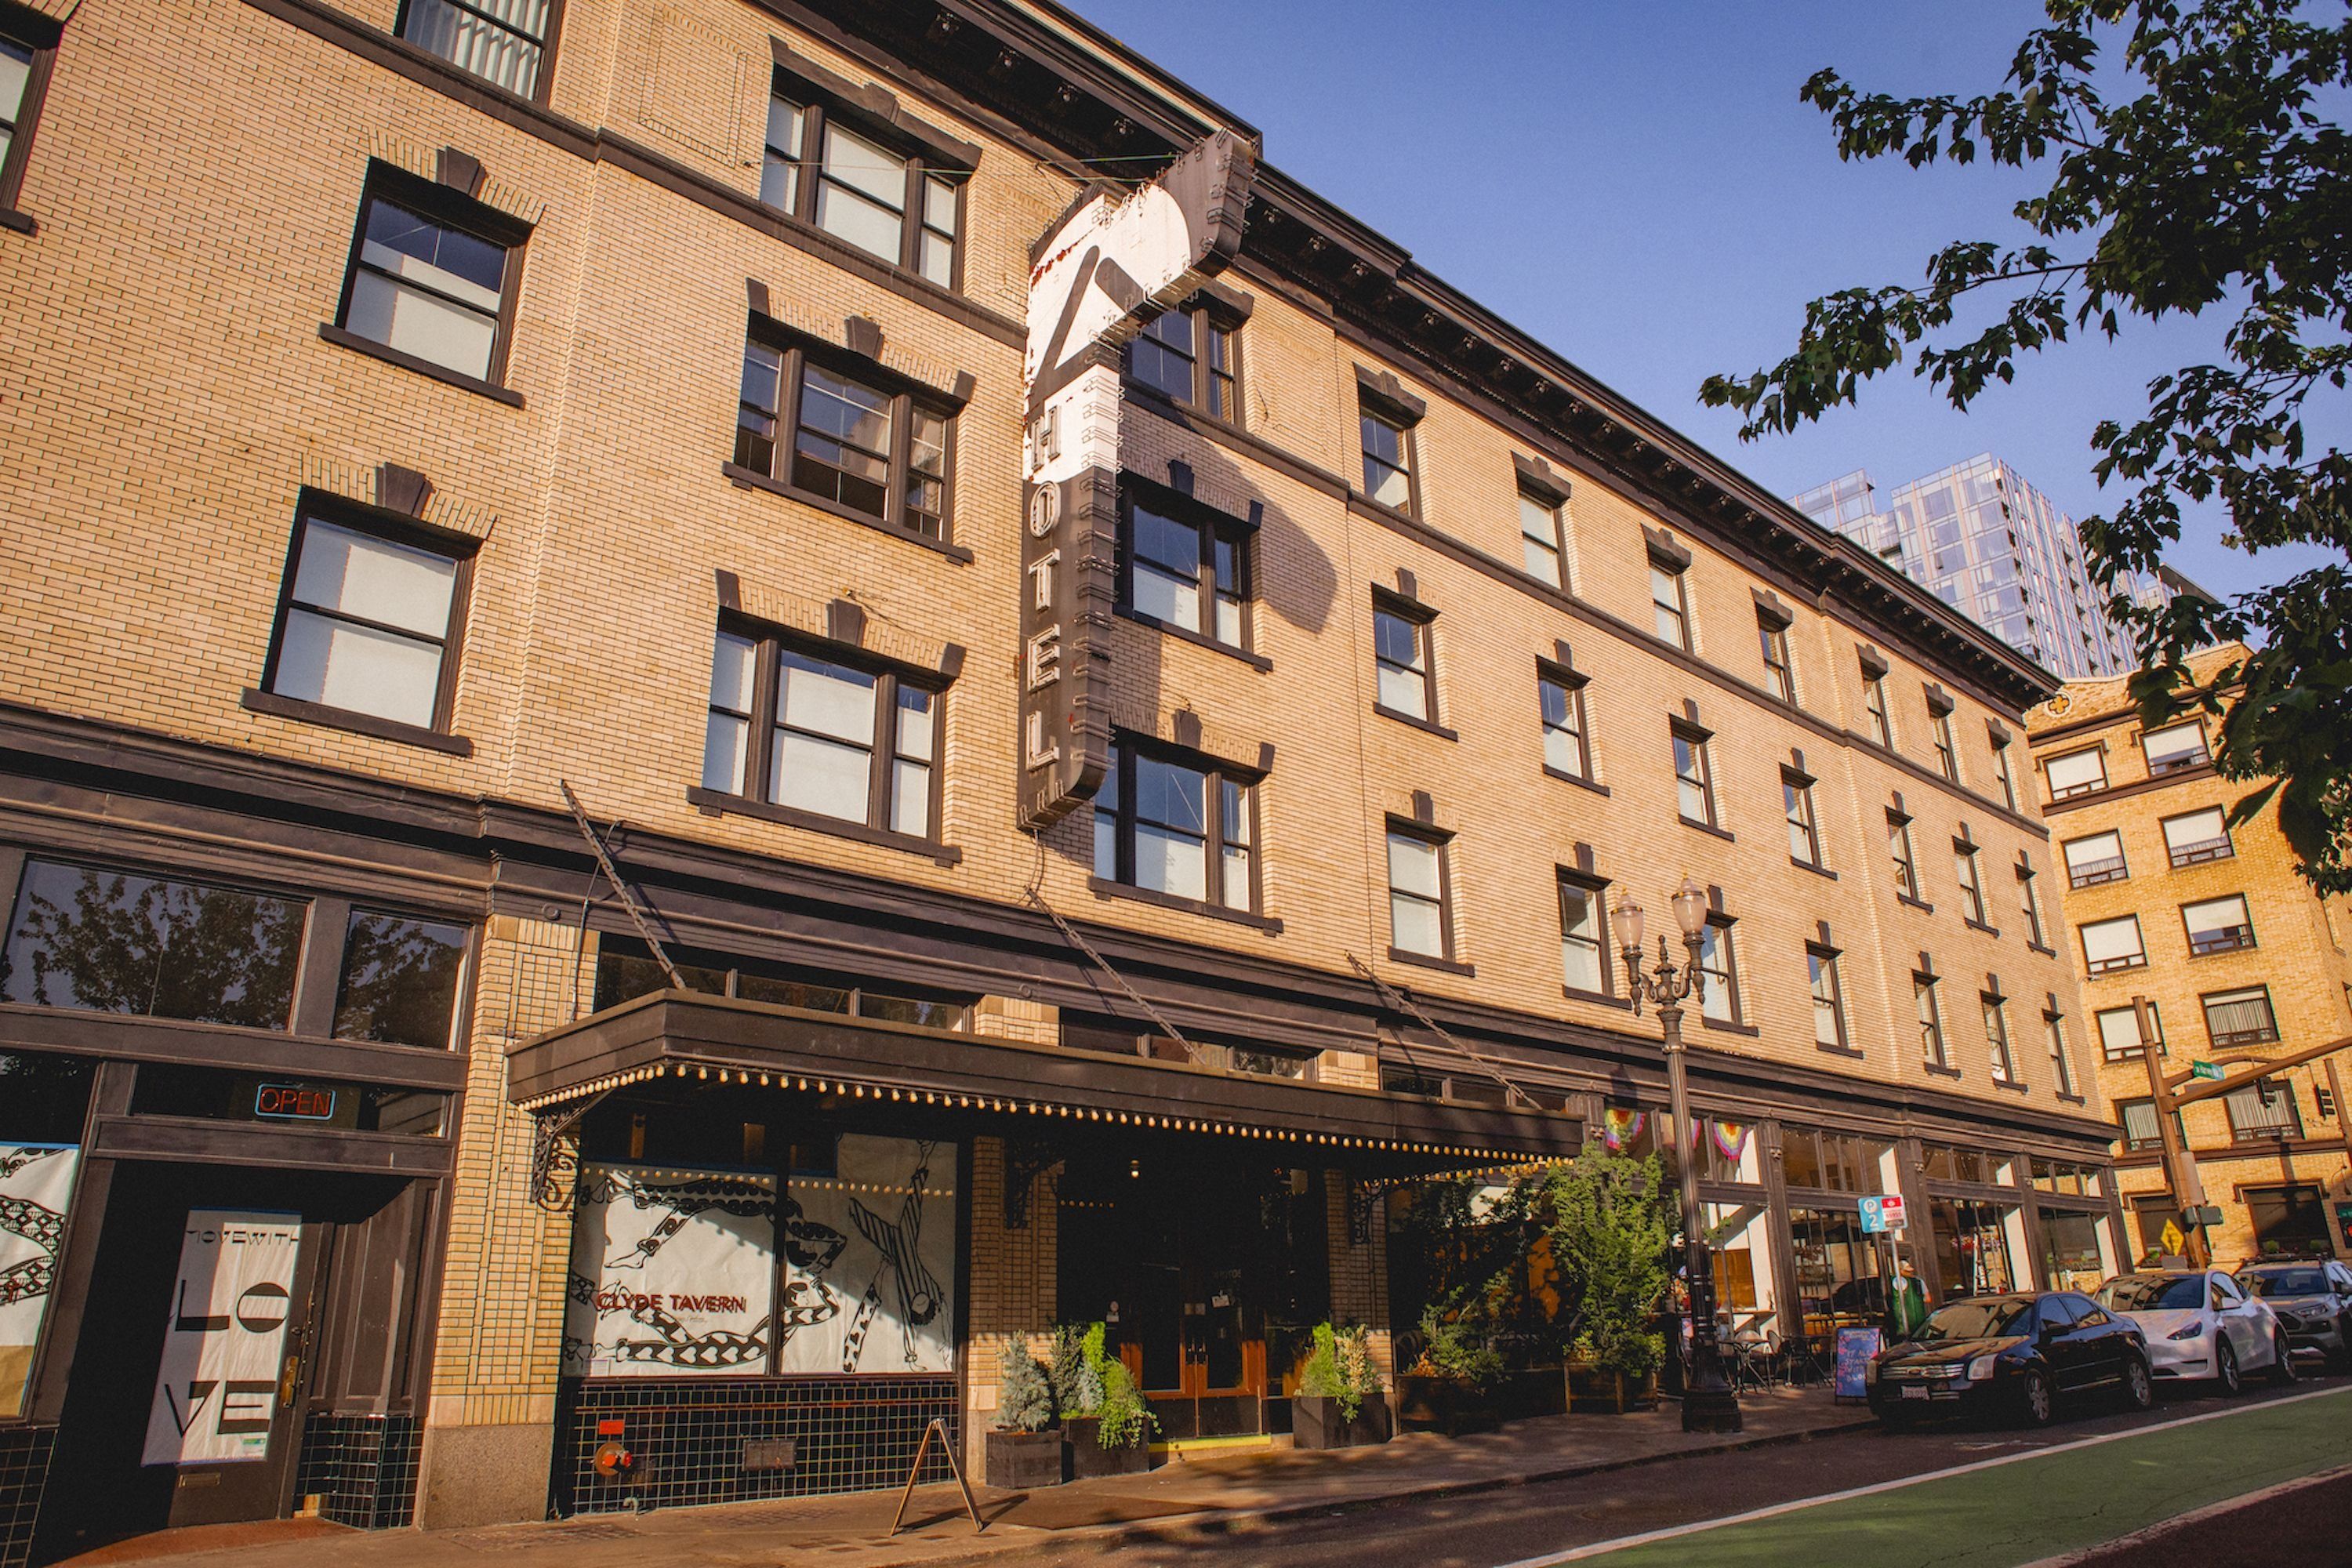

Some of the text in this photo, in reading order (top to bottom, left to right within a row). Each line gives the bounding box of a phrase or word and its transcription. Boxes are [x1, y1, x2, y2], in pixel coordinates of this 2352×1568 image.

[1025, 404, 1062, 771] HOTEL
[260, 1088, 332, 1116] OPEN
[1868, 1214, 1879, 1228] 2
[175, 1279, 289, 1334] LO
[596, 1294, 749, 1313] CLYDE TAVERN
[165, 1380, 276, 1439] VE
